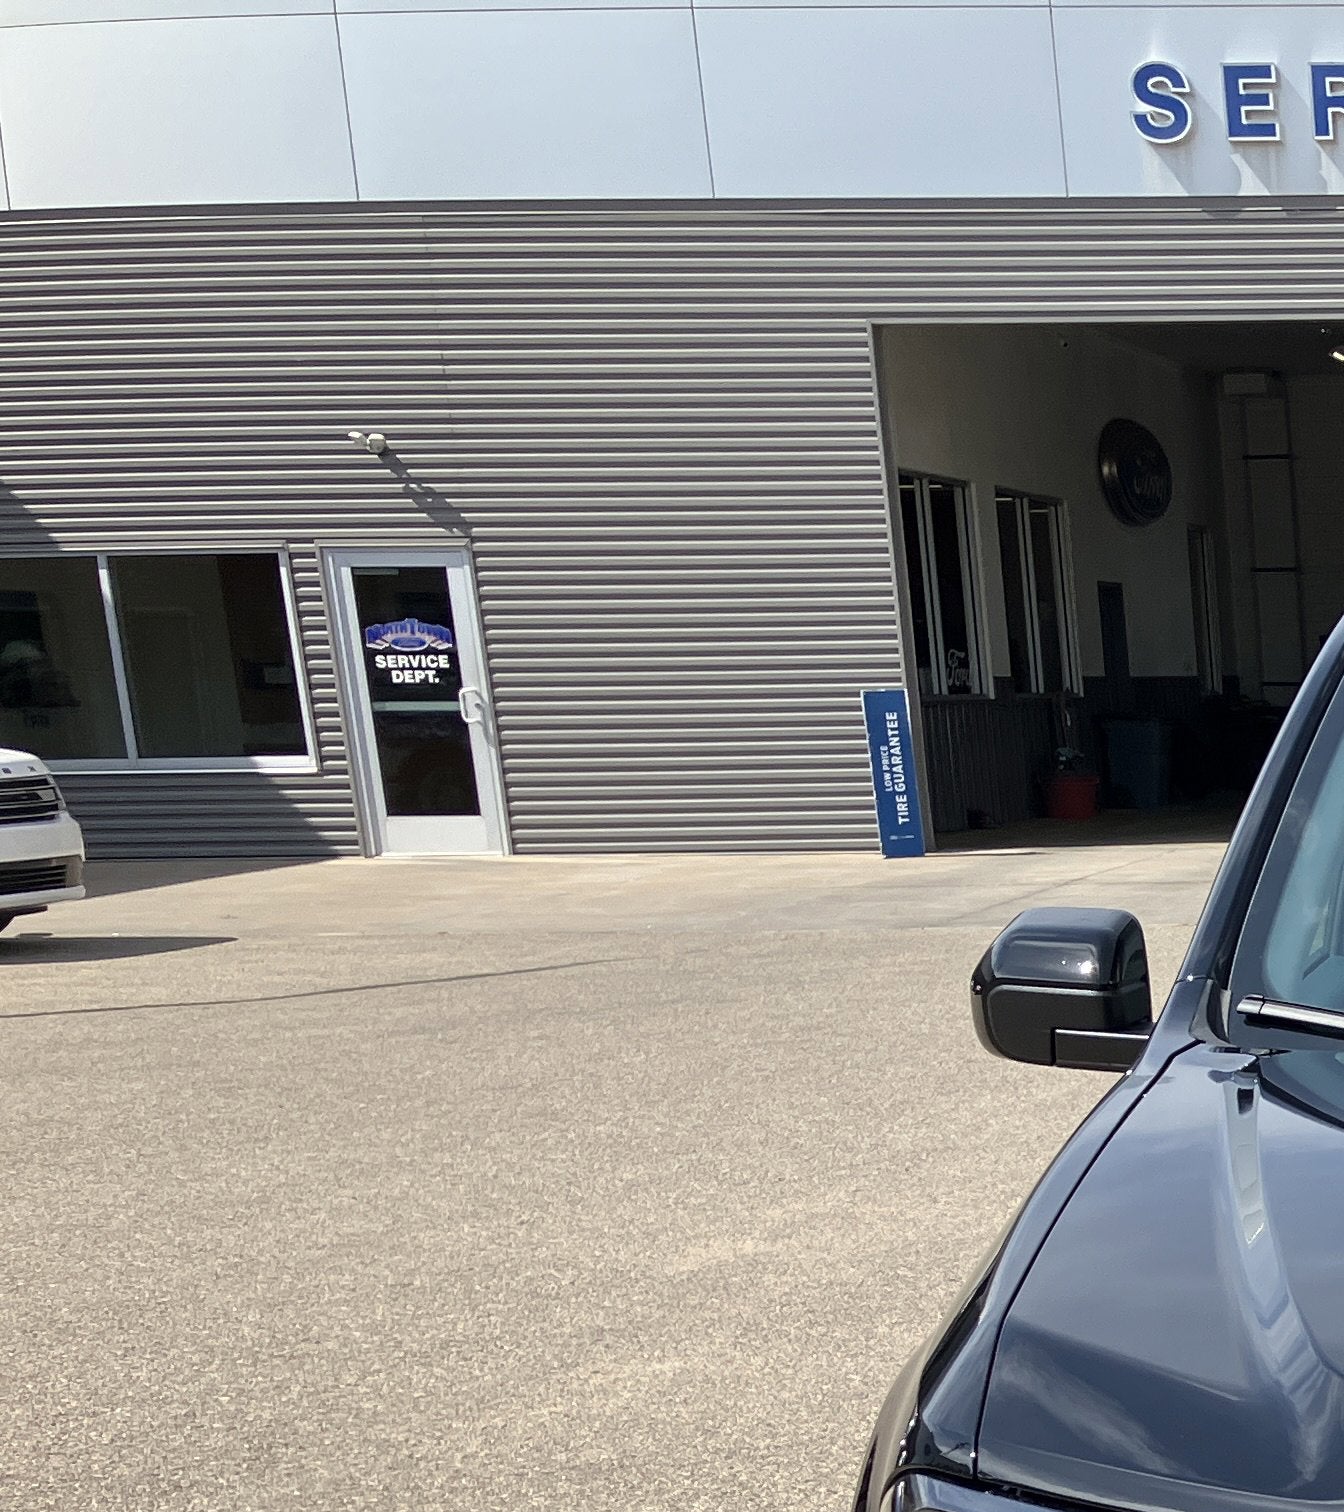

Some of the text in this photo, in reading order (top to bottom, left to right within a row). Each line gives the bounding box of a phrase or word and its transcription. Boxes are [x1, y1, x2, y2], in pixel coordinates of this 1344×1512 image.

[375, 654, 450, 668] SERVICE
[391, 670, 440, 684] DEPT.
[885, 711, 907, 792] GUARANTEE
[880, 745, 893, 792] LOW PRICE
[896, 794, 910, 825] TIRE
